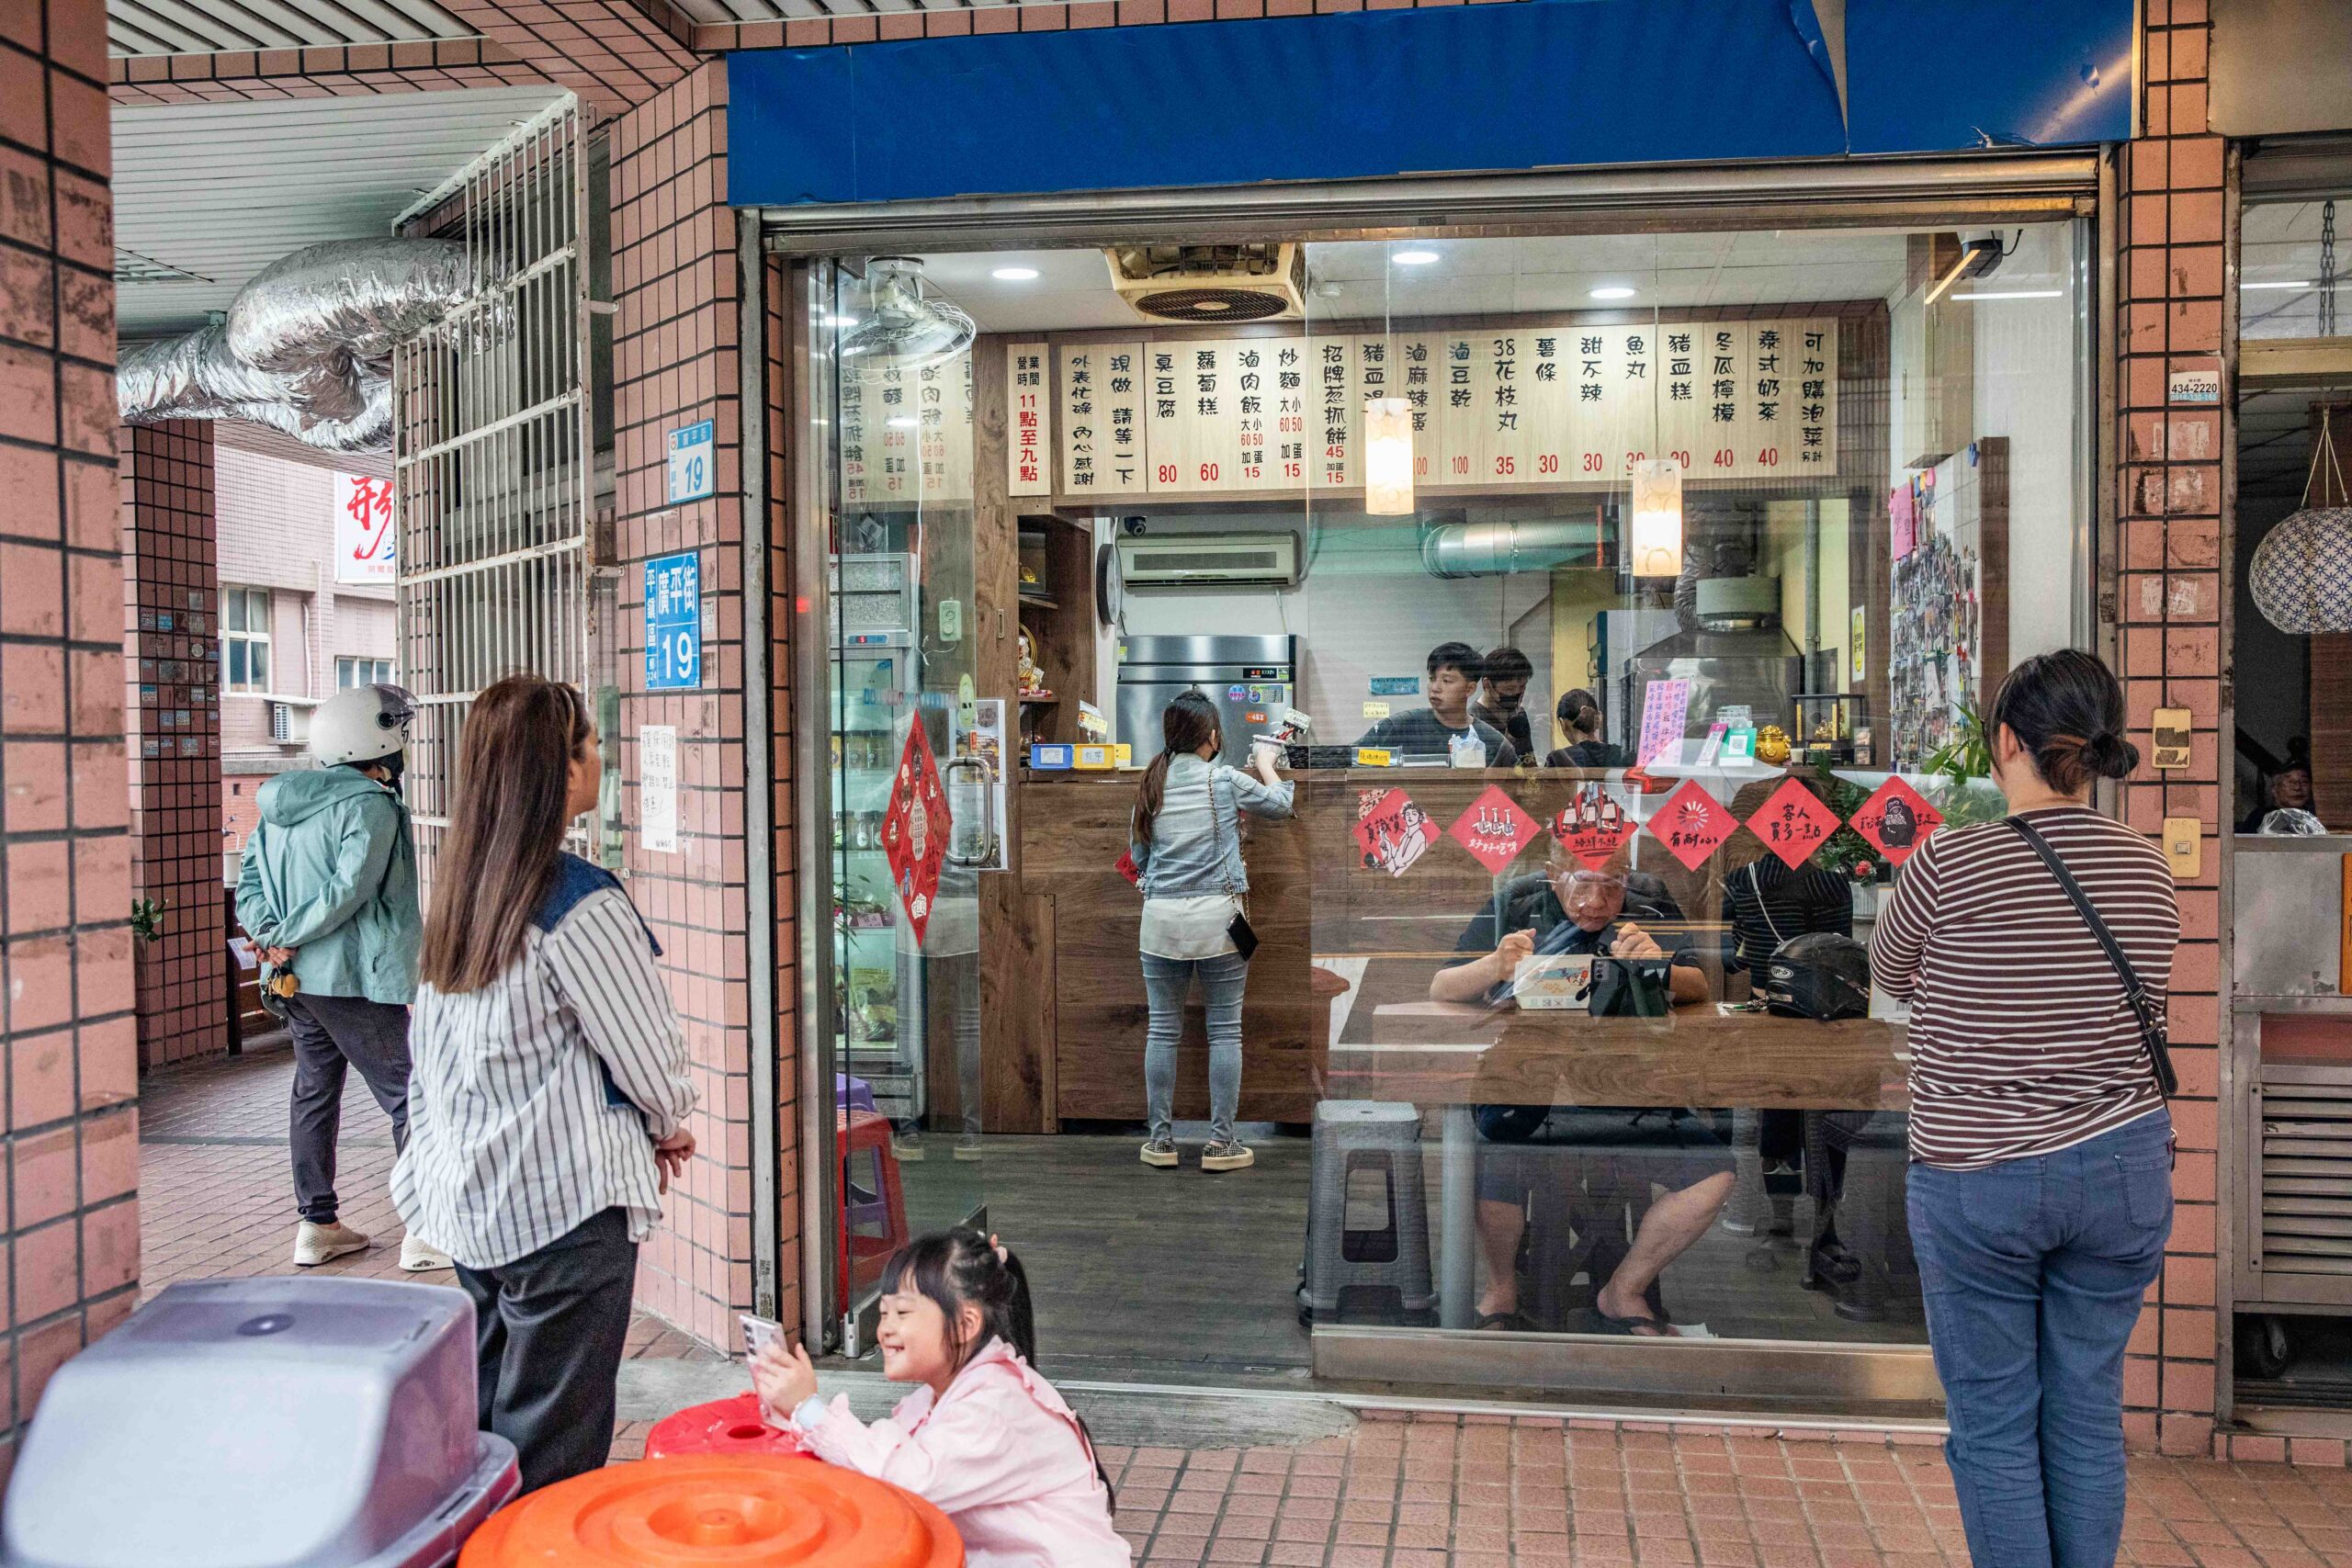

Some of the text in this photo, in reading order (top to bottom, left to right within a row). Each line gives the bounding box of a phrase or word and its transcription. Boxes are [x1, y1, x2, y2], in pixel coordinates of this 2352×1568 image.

[1536, 338, 1556, 381] 薯條
[1626, 336, 1645, 378] 魚丸
[1279, 348, 1300, 389] 炒麵
[1450, 342, 1471, 408] 滷豆乾
[1581, 337, 1602, 401] 甜不辣
[1668, 333, 1692, 400] 豬血糕
[1197, 351, 1218, 415] 蘿蔔糕
[1239, 350, 1261, 413] 滷肉飯
[1494, 339, 1517, 431] 38花枝丸
[1713, 333, 1735, 422] 冬瓜檸檬
[1758, 331, 1781, 421] 泰式奶茶
[1155, 354, 1176, 418] 臭豆腐
[1803, 333, 1825, 446] 可加購泡菜
[2171, 383, 2218, 393] 434-2220
[1281, 397, 1301, 412] 大 小
[1071, 355, 1093, 485] 外表忙碌 內心感謝
[1111, 355, 1134, 484] 現做 請等一下
[1241, 418, 1261, 431] 大 小
[1280, 417, 1302, 432] 60 50
[1241, 434, 1262, 446] 60 50
[1242, 451, 1262, 464] 加蛋
[1282, 444, 1302, 458] 加蛋
[1326, 446, 1344, 457] 45
[1714, 449, 1733, 467] 40
[1758, 448, 1778, 466] 40
[1285, 464, 1300, 477] 15
[1453, 457, 1468, 474] 100
[1497, 457, 1514, 474] 35
[1540, 455, 1557, 473] 30
[1584, 454, 1602, 471] 30
[685, 456, 703, 492] 19
[1159, 465, 1176, 482] 80
[1201, 464, 1218, 480] 60
[1245, 467, 1260, 478] 15
[1328, 472, 1343, 483] 15
[658, 566, 695, 615] 廣平街
[647, 569, 656, 648] 平鎮區
[662, 632, 693, 679] 19
[1782, 803, 1810, 821] 客人
[1670, 830, 1718, 848] 有耐心
[1770, 822, 1821, 841] 買多一點
